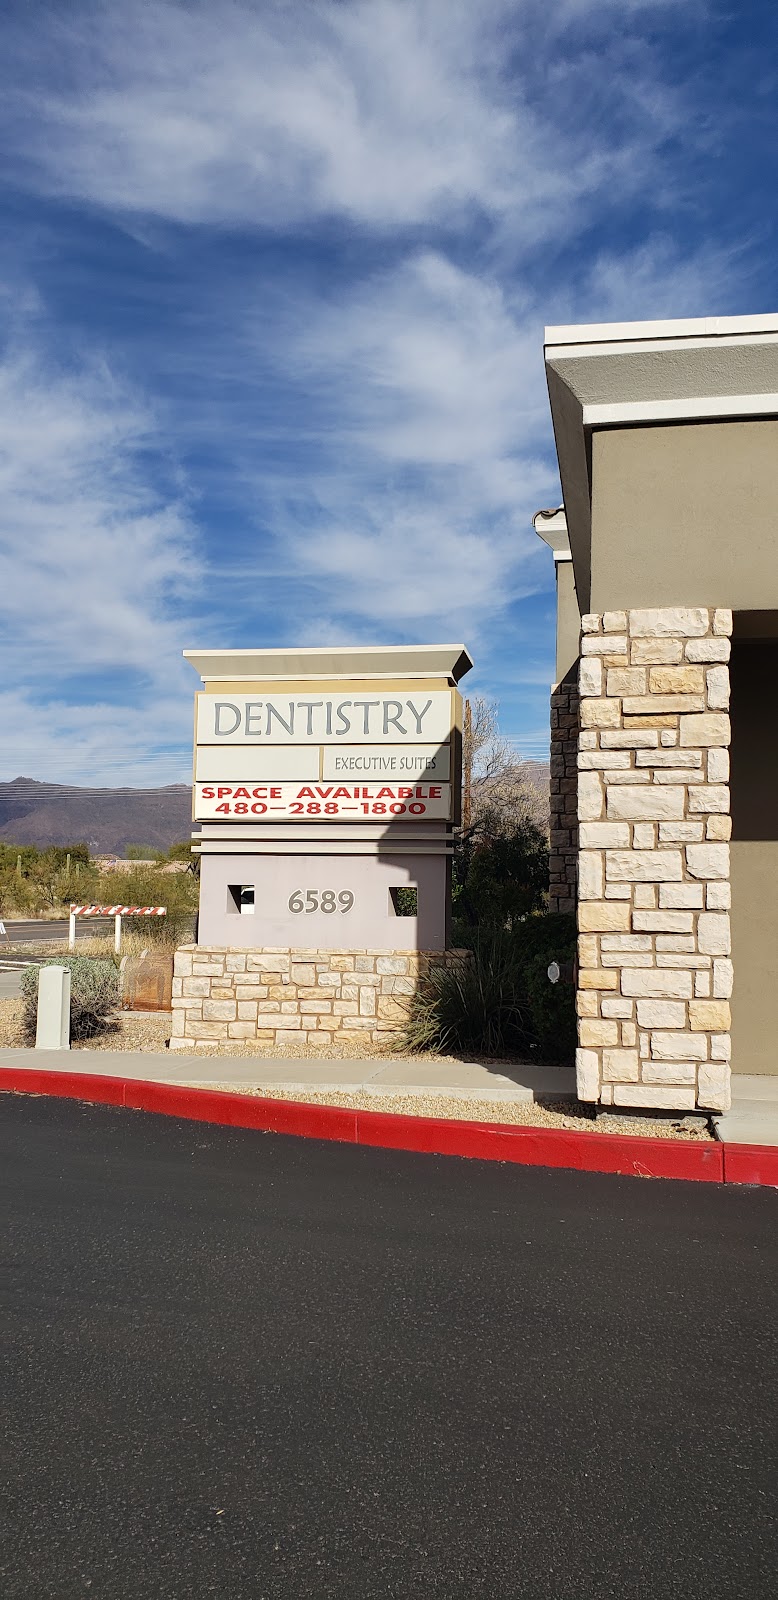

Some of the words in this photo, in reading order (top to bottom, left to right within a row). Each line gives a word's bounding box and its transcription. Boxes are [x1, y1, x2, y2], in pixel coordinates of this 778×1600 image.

[214, 699, 432, 736] DENTISTRY
[335, 756, 396, 770] EXECUTIVE
[399, 756, 437, 770] SUITES
[201, 787, 282, 799] SPACE
[296, 786, 442, 799] AVAILABLE
[288, 888, 355, 916] 6589
